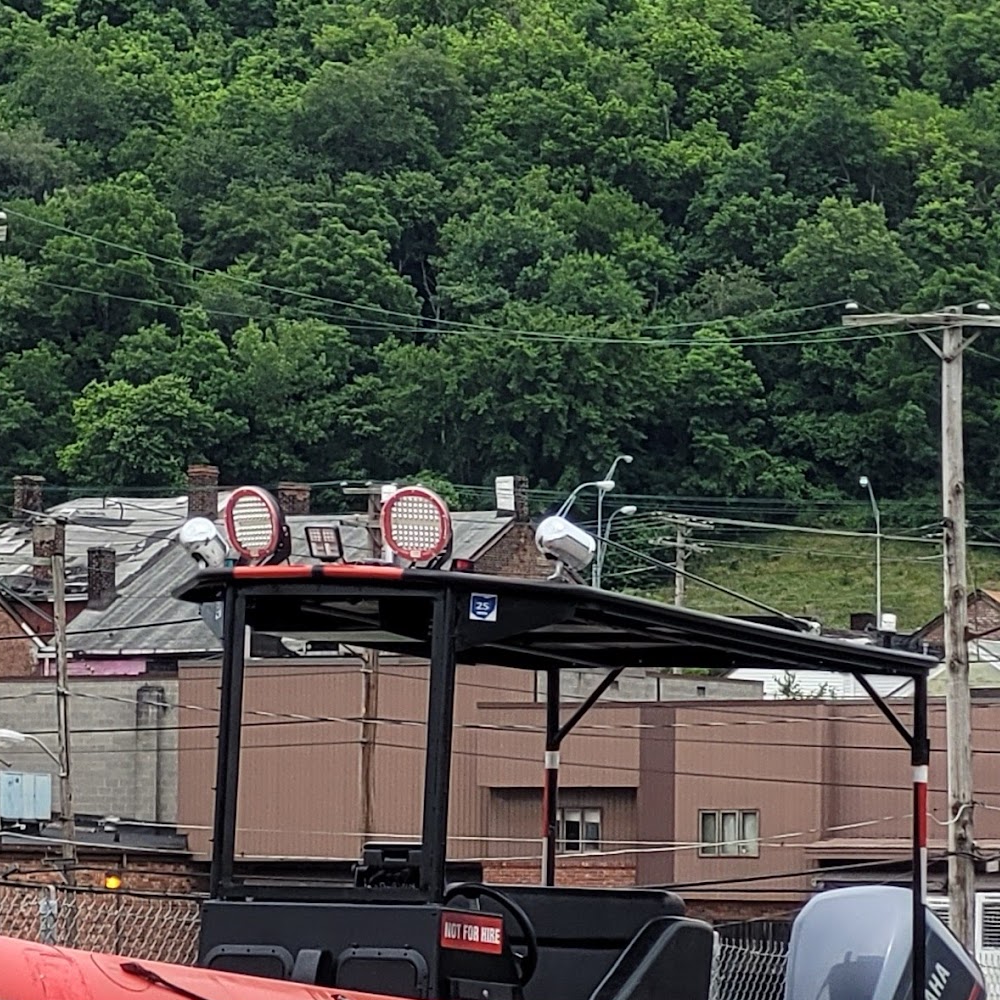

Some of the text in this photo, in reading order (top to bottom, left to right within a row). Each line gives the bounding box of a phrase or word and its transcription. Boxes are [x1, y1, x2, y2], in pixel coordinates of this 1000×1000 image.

[444, 921, 501, 945] NOT FOR HIRE
